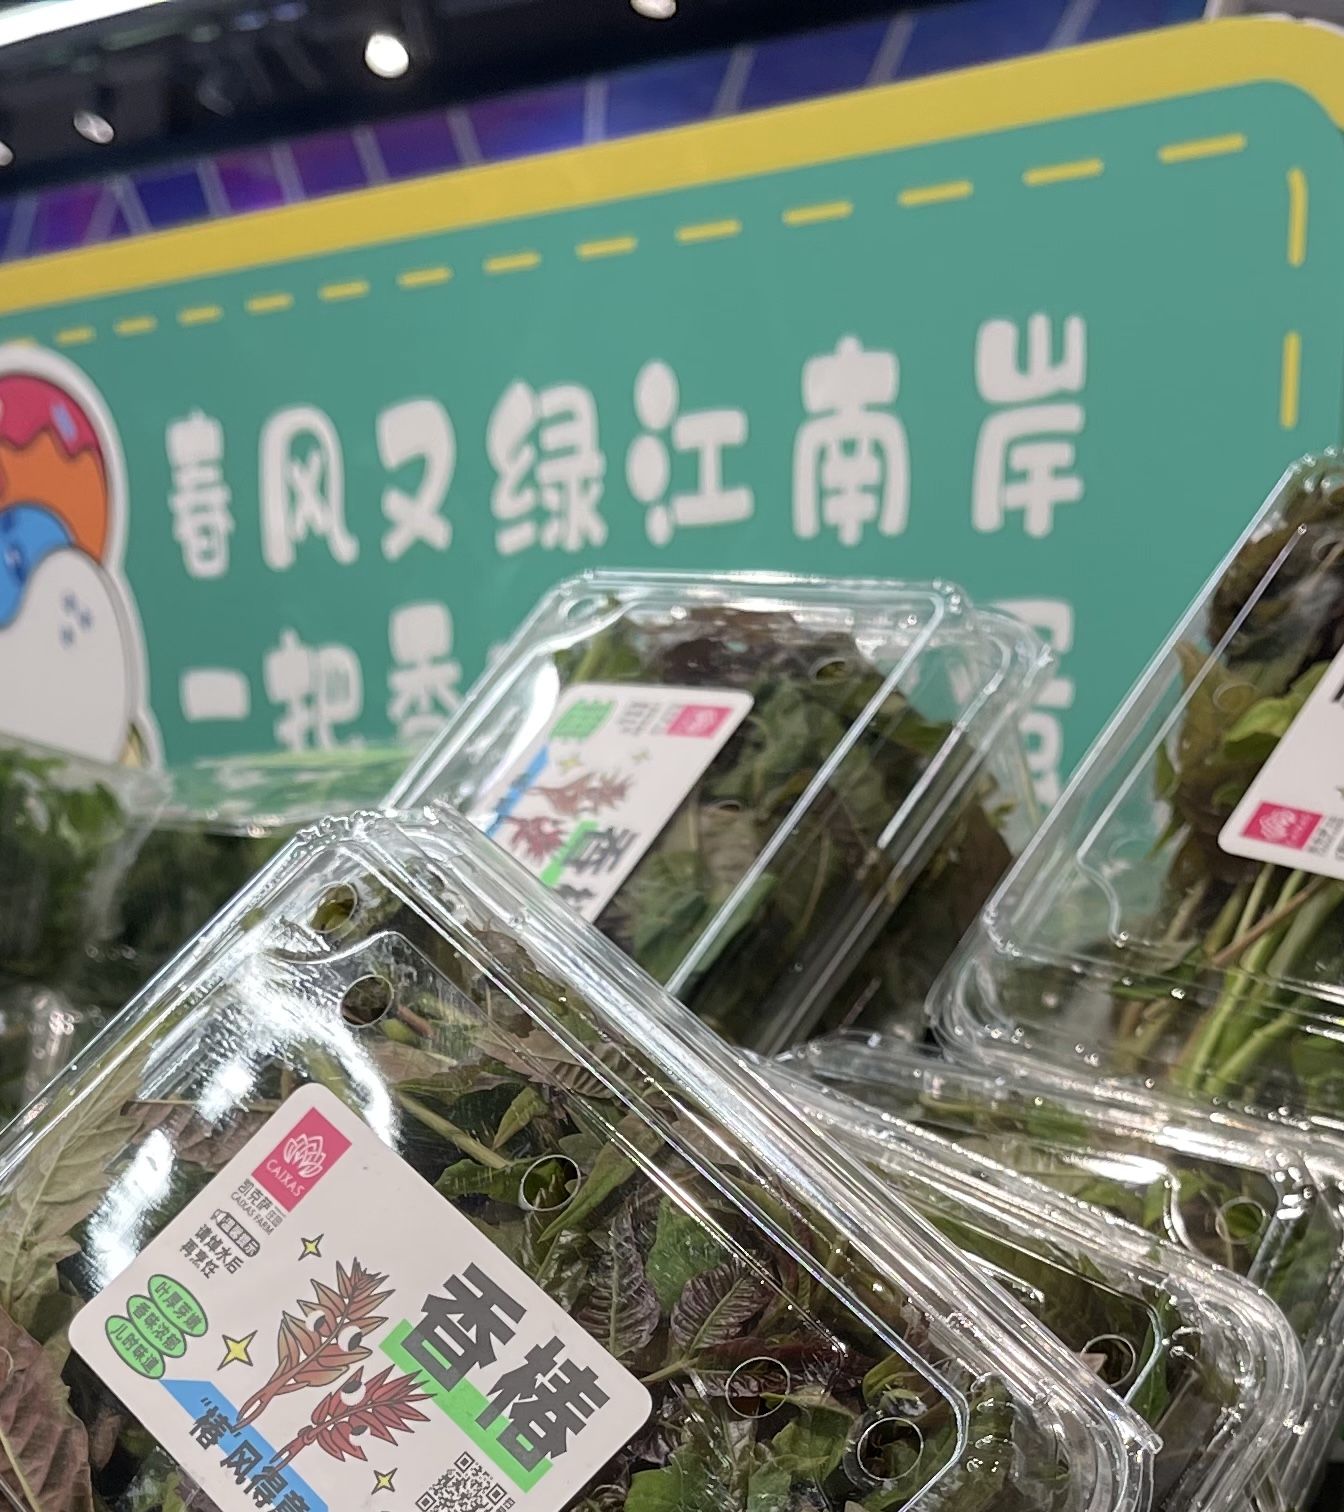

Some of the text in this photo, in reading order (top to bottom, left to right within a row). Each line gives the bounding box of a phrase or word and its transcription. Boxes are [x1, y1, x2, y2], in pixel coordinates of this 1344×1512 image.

[166, 312, 1087, 578] 春风又绿江南岸
[266, 1159, 304, 1196] CAIXAS
[400, 1262, 609, 1472] 香椿
